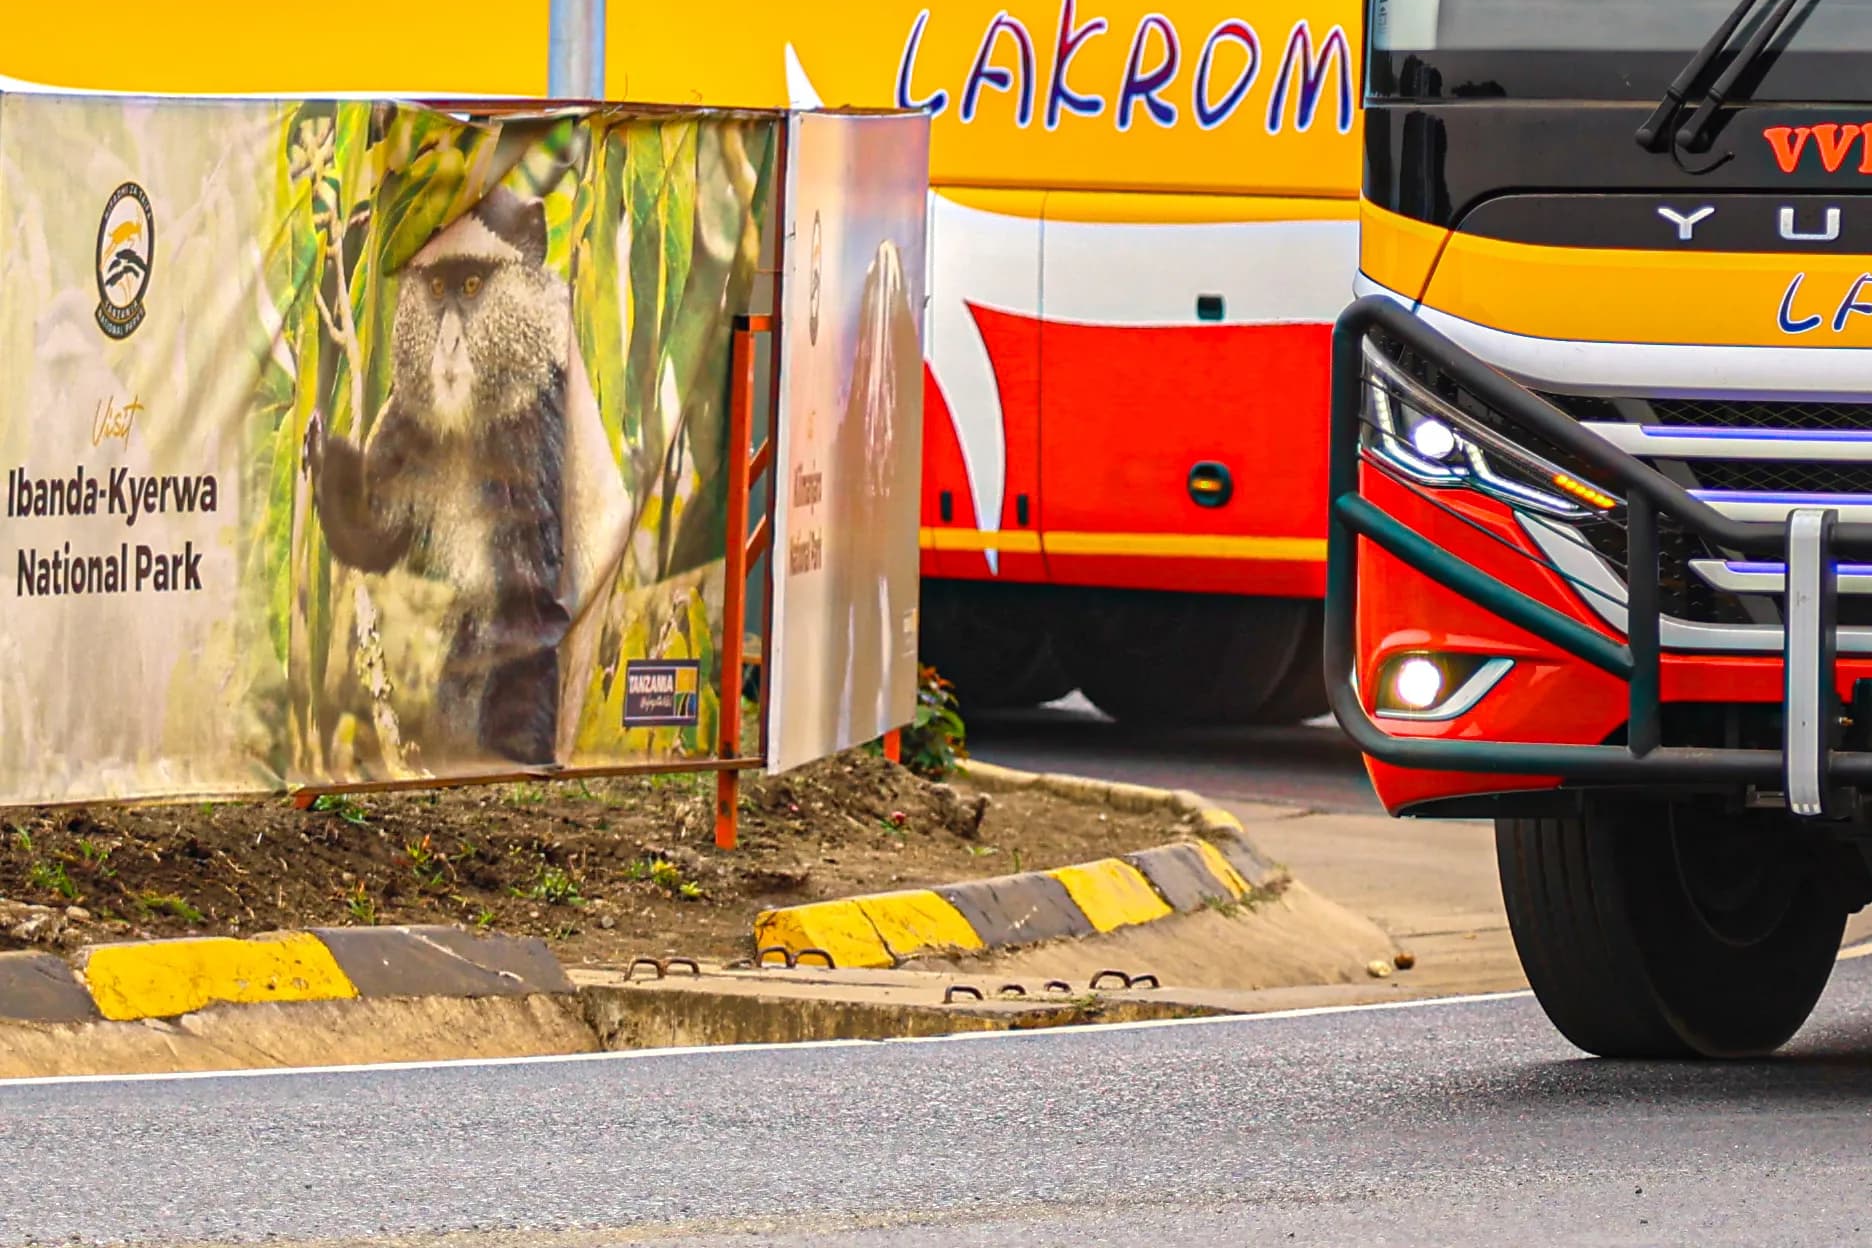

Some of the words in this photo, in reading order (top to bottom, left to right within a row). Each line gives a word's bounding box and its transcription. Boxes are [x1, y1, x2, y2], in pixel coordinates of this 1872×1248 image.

[91, 394, 144, 451] Visit
[7, 465, 218, 527] Ibanda-Kyerwa
[17, 541, 128, 596] National
[135, 541, 203, 592] Park
